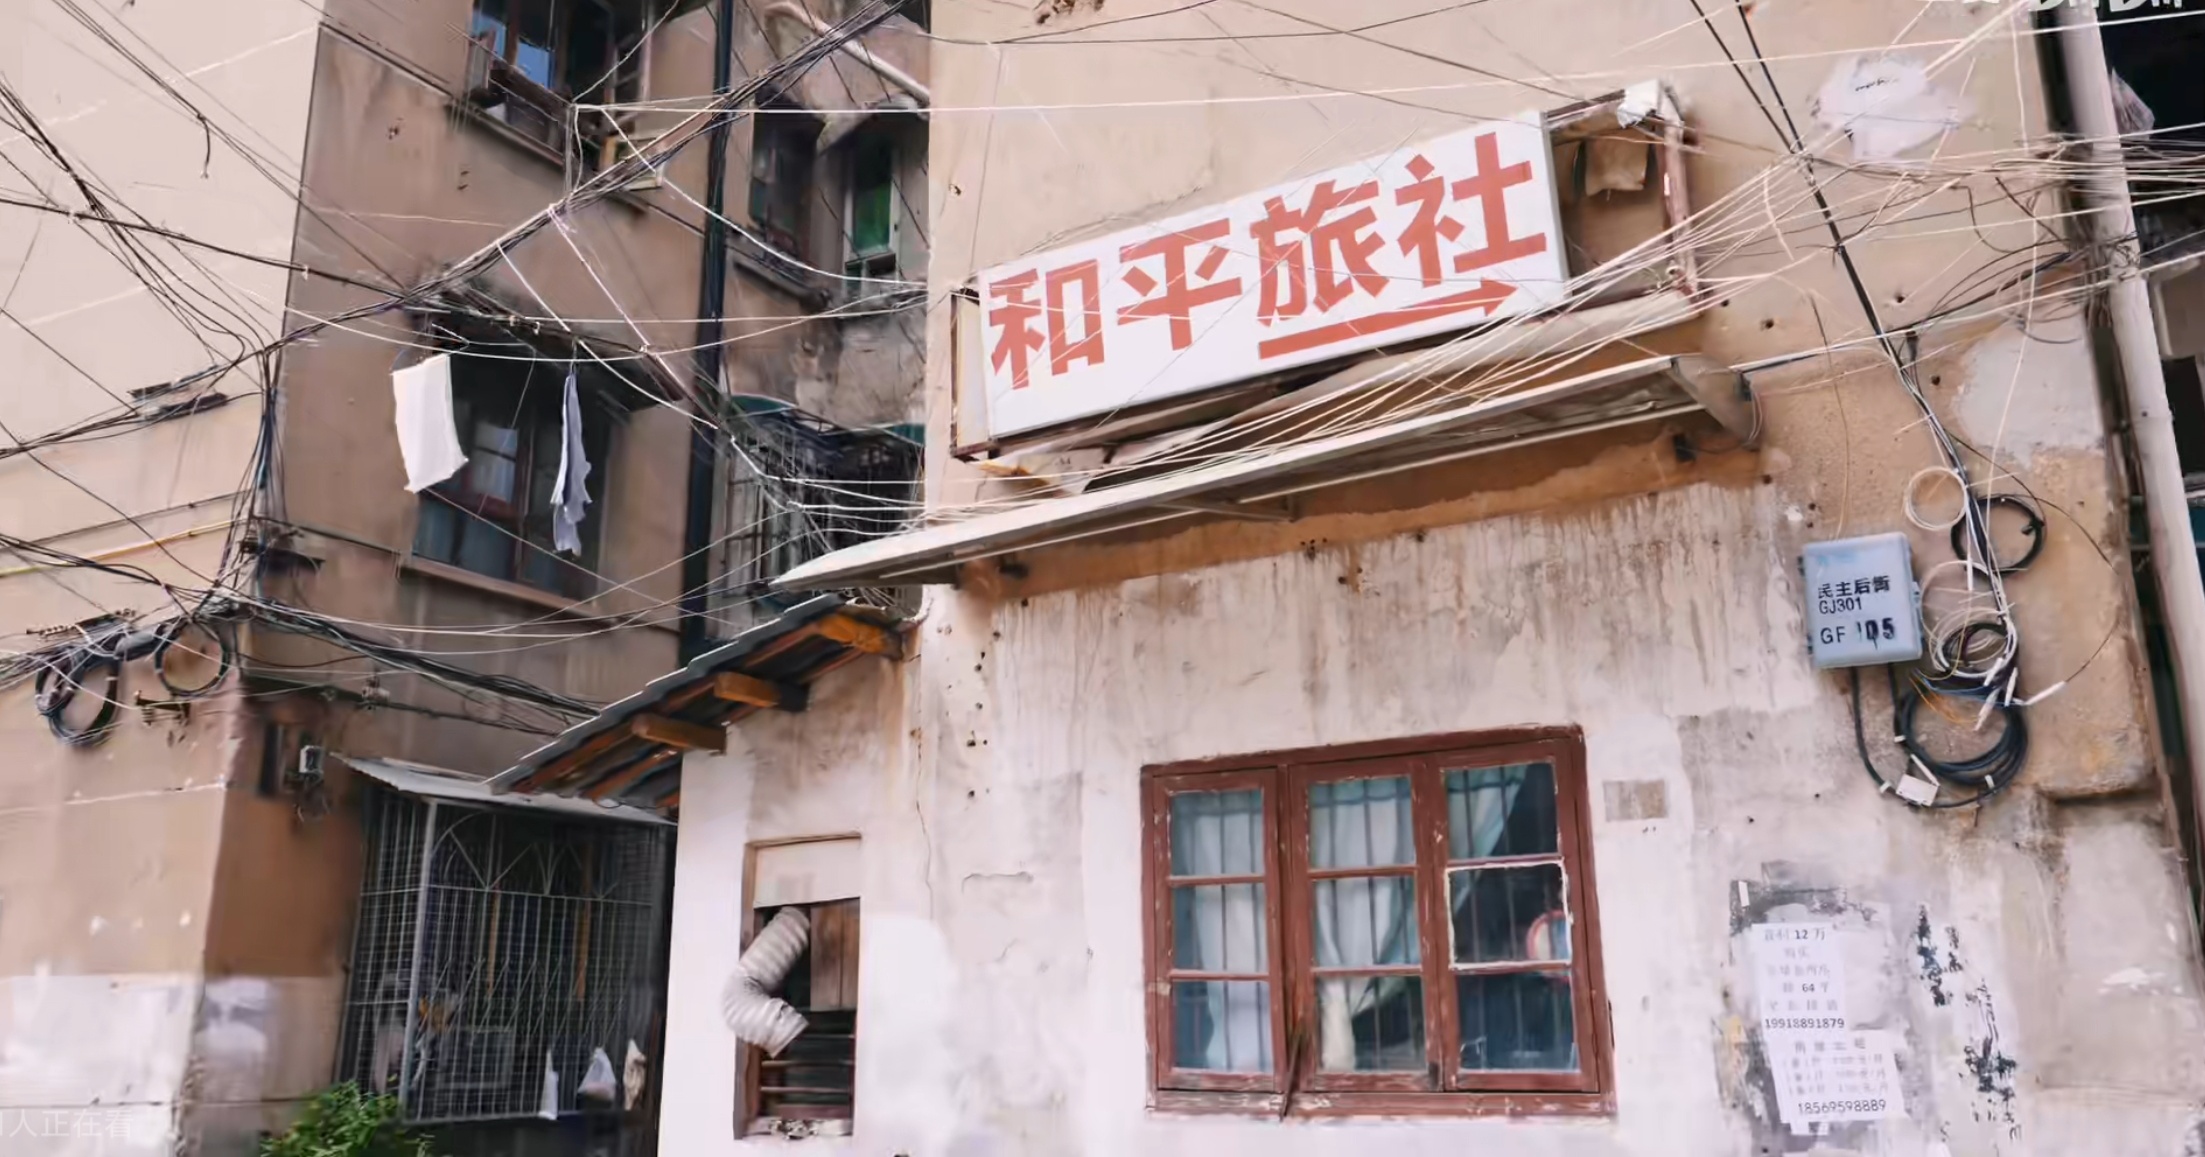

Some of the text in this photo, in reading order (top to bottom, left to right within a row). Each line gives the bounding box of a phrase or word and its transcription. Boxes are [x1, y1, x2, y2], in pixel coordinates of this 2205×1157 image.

[989, 132, 1547, 390] 和平旅社
[1819, 597, 1862, 614] GJ301
[1820, 626, 1846, 644] GF
[1795, 929, 1809, 940] 12
[1802, 983, 1815, 993] 64
[1765, 1018, 1845, 1029] 19918891879
[1798, 1099, 1887, 1115] 18569598889
